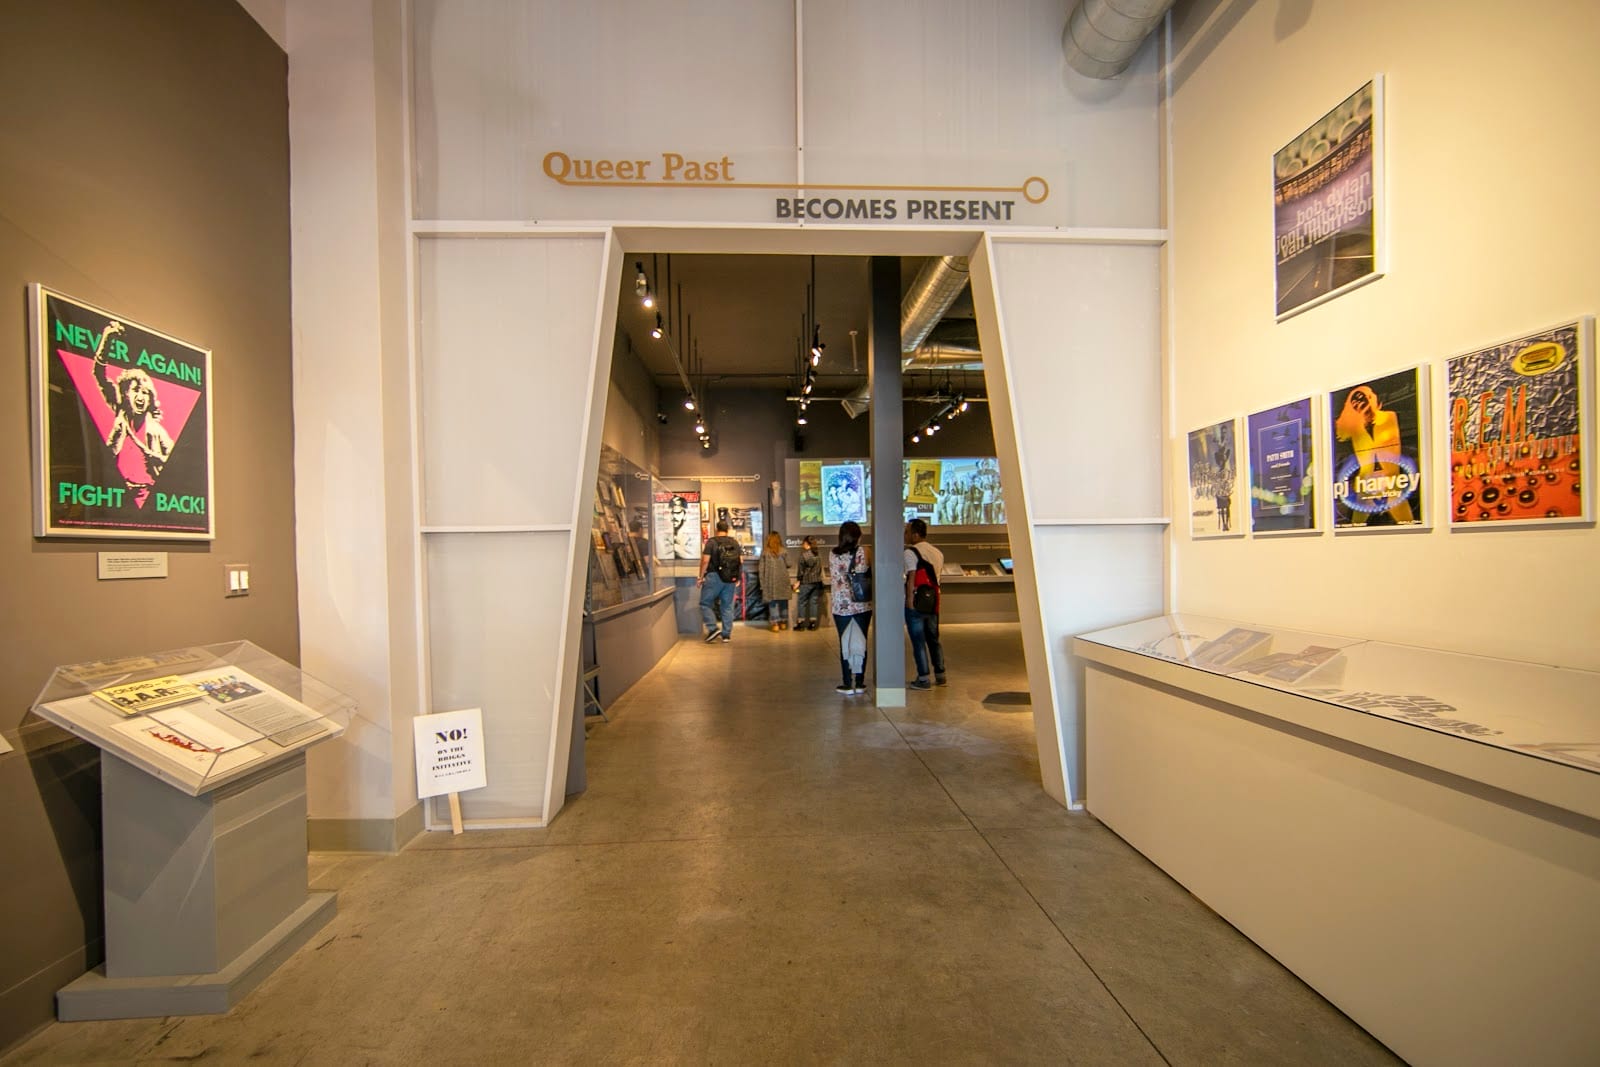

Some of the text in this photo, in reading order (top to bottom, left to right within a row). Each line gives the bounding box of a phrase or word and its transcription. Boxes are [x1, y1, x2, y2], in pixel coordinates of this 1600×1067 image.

[542, 152, 735, 185] Queer Past
[776, 197, 1014, 221] BECOMES PRESENT
[1296, 171, 1370, 224] bob dylan
[136, 349, 202, 386] AGAIN!
[1453, 384, 1536, 452] R.E.M.
[58, 482, 206, 516] FIGHT BACK!
[1334, 472, 1420, 499] pj harvey
[435, 728, 468, 744] NO!
